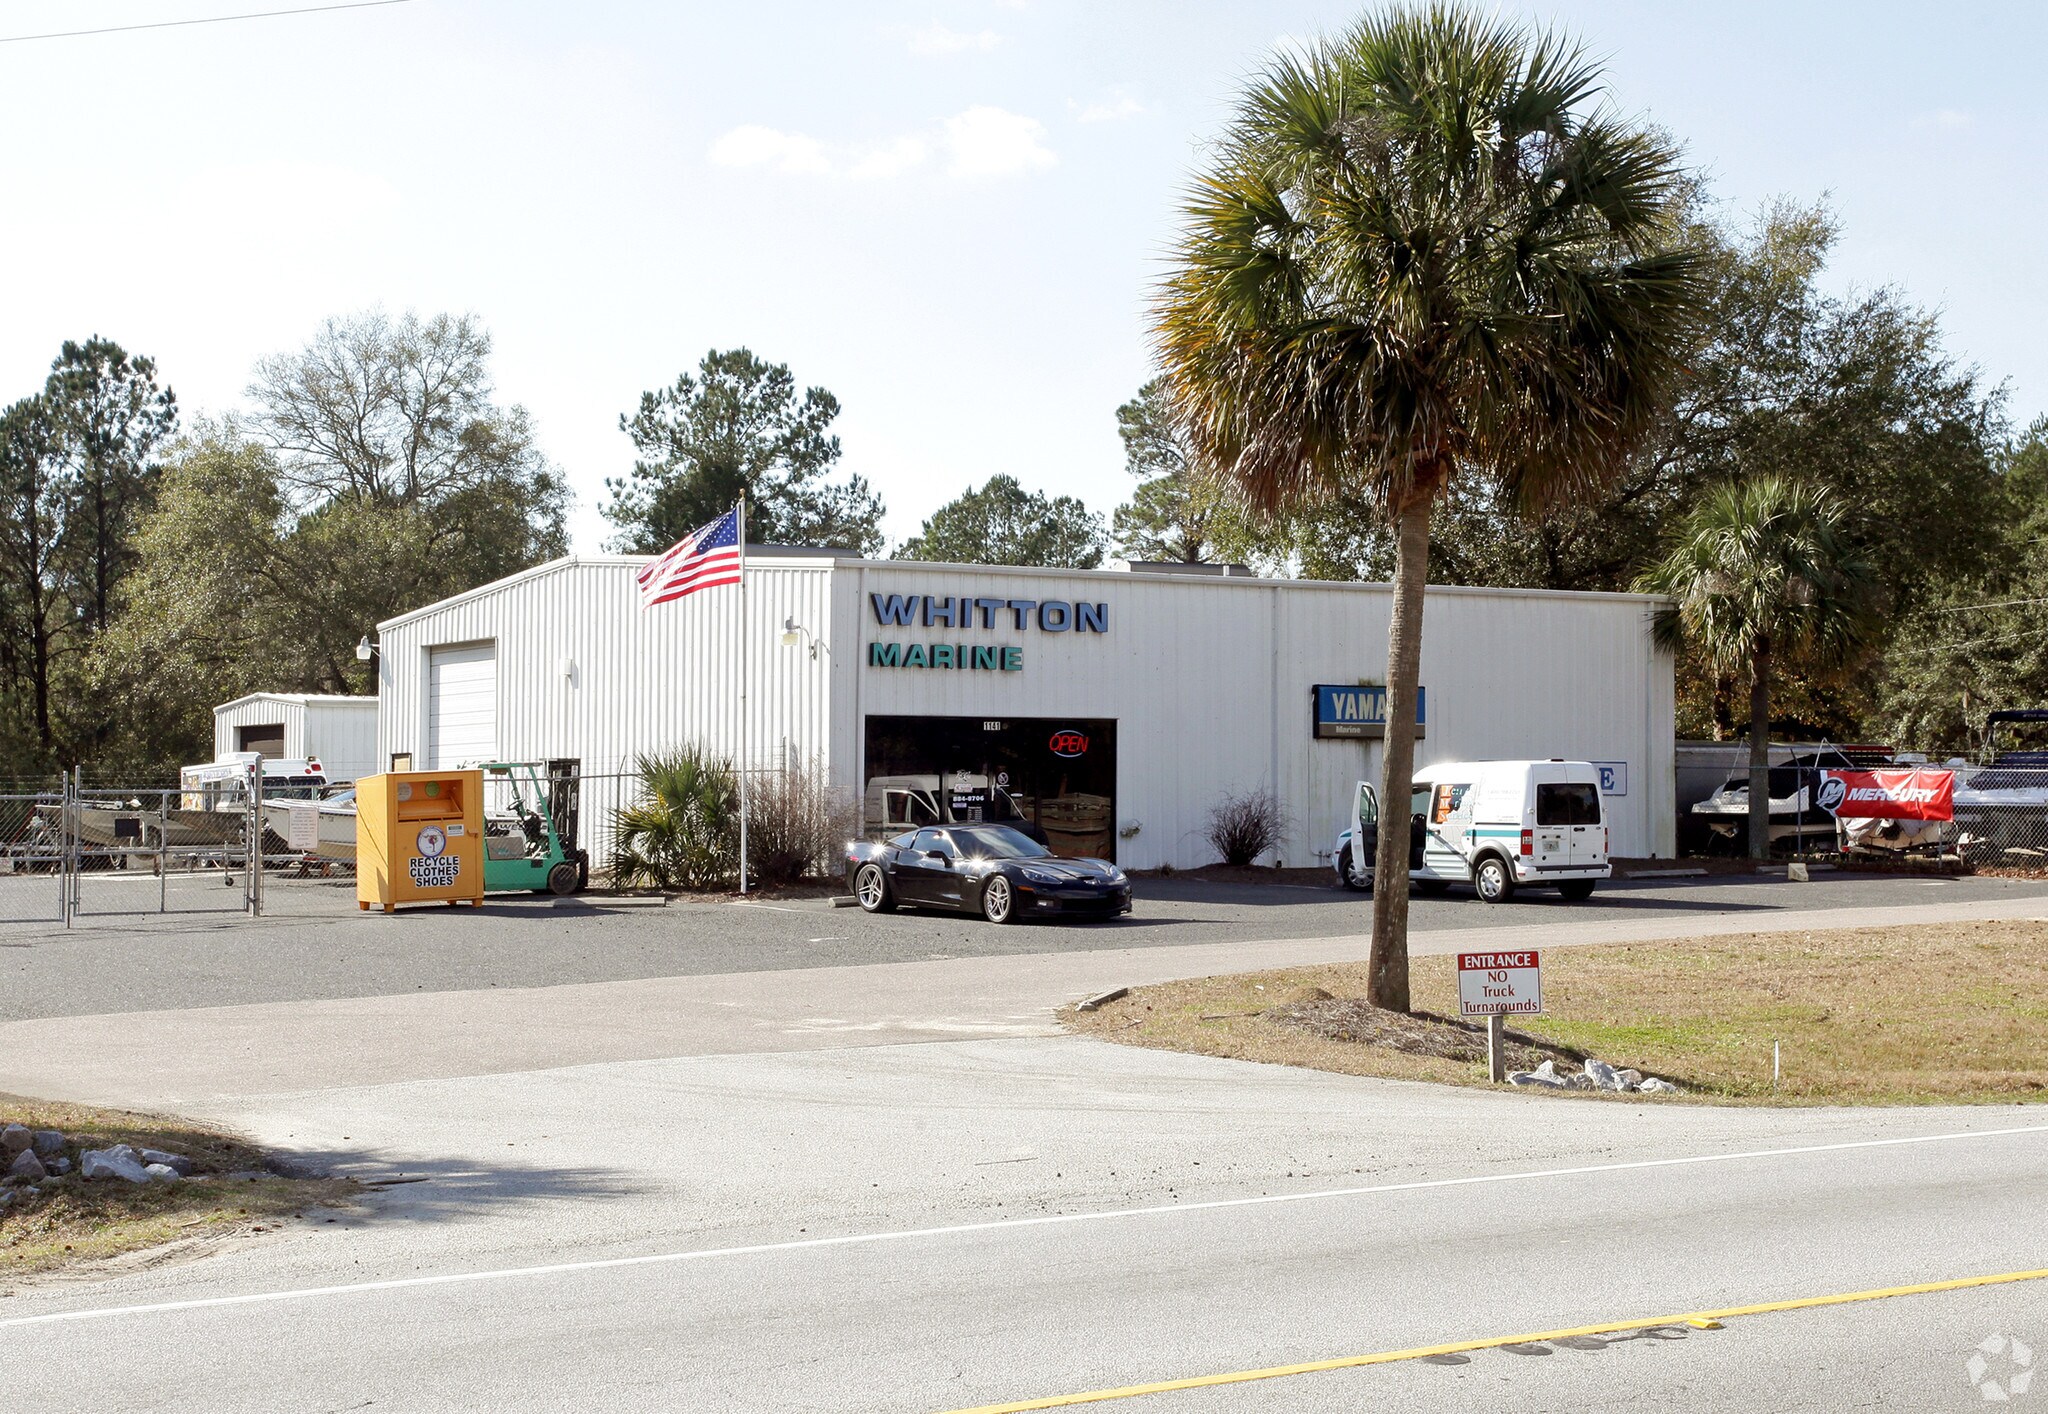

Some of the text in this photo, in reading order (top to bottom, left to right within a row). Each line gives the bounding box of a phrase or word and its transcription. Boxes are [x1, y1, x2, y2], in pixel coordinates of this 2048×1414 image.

[870, 592, 1108, 633] WHITTON
[869, 642, 1023, 671] MARINE
[1331, 692, 1387, 720] YAMA
[1335, 725, 1361, 734] Marine
[1049, 734, 1089, 752] OPEN
[1847, 787, 1940, 803] MERCURY
[410, 856, 459, 868] RECYCLE
[410, 866, 459, 878] CLOTHES
[416, 876, 453, 887] SHOES
[1464, 953, 1531, 968] ENTRANCE
[1487, 970, 1508, 983] NO
[1482, 984, 1515, 997] Truck
[1463, 998, 1538, 1013] Turnarounds
